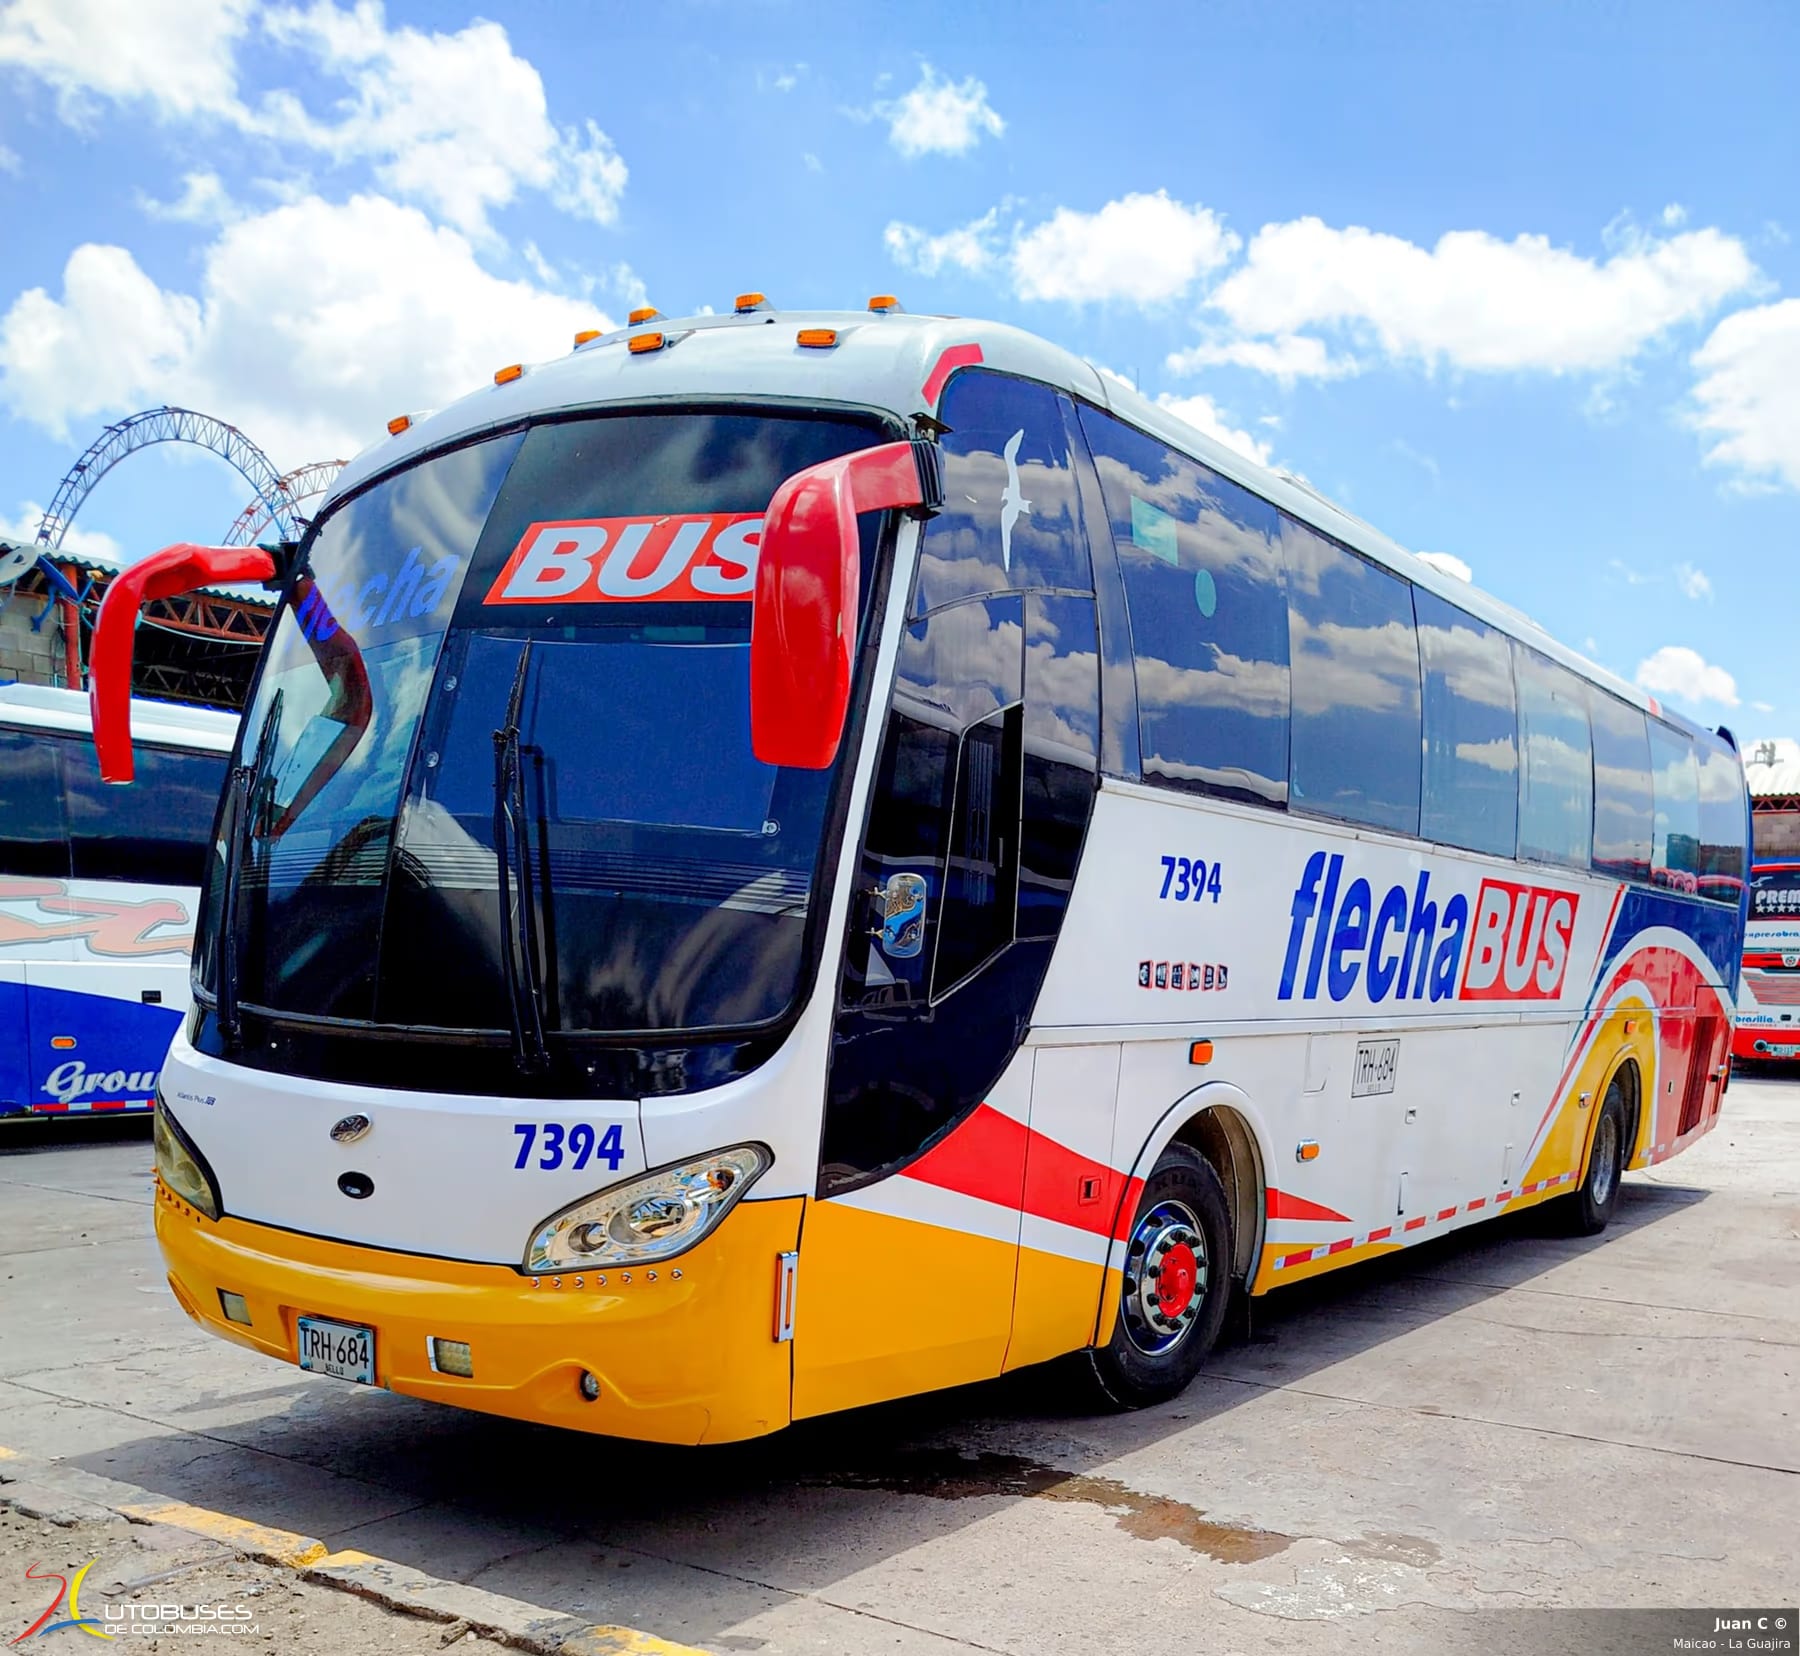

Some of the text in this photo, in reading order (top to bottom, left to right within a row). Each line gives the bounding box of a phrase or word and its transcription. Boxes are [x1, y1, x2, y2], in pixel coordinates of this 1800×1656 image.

[501, 518, 764, 598] BUS
[1159, 856, 1222, 903] 7394
[40, 1061, 160, 1104] Grou
[514, 1123, 625, 1170] 7394
